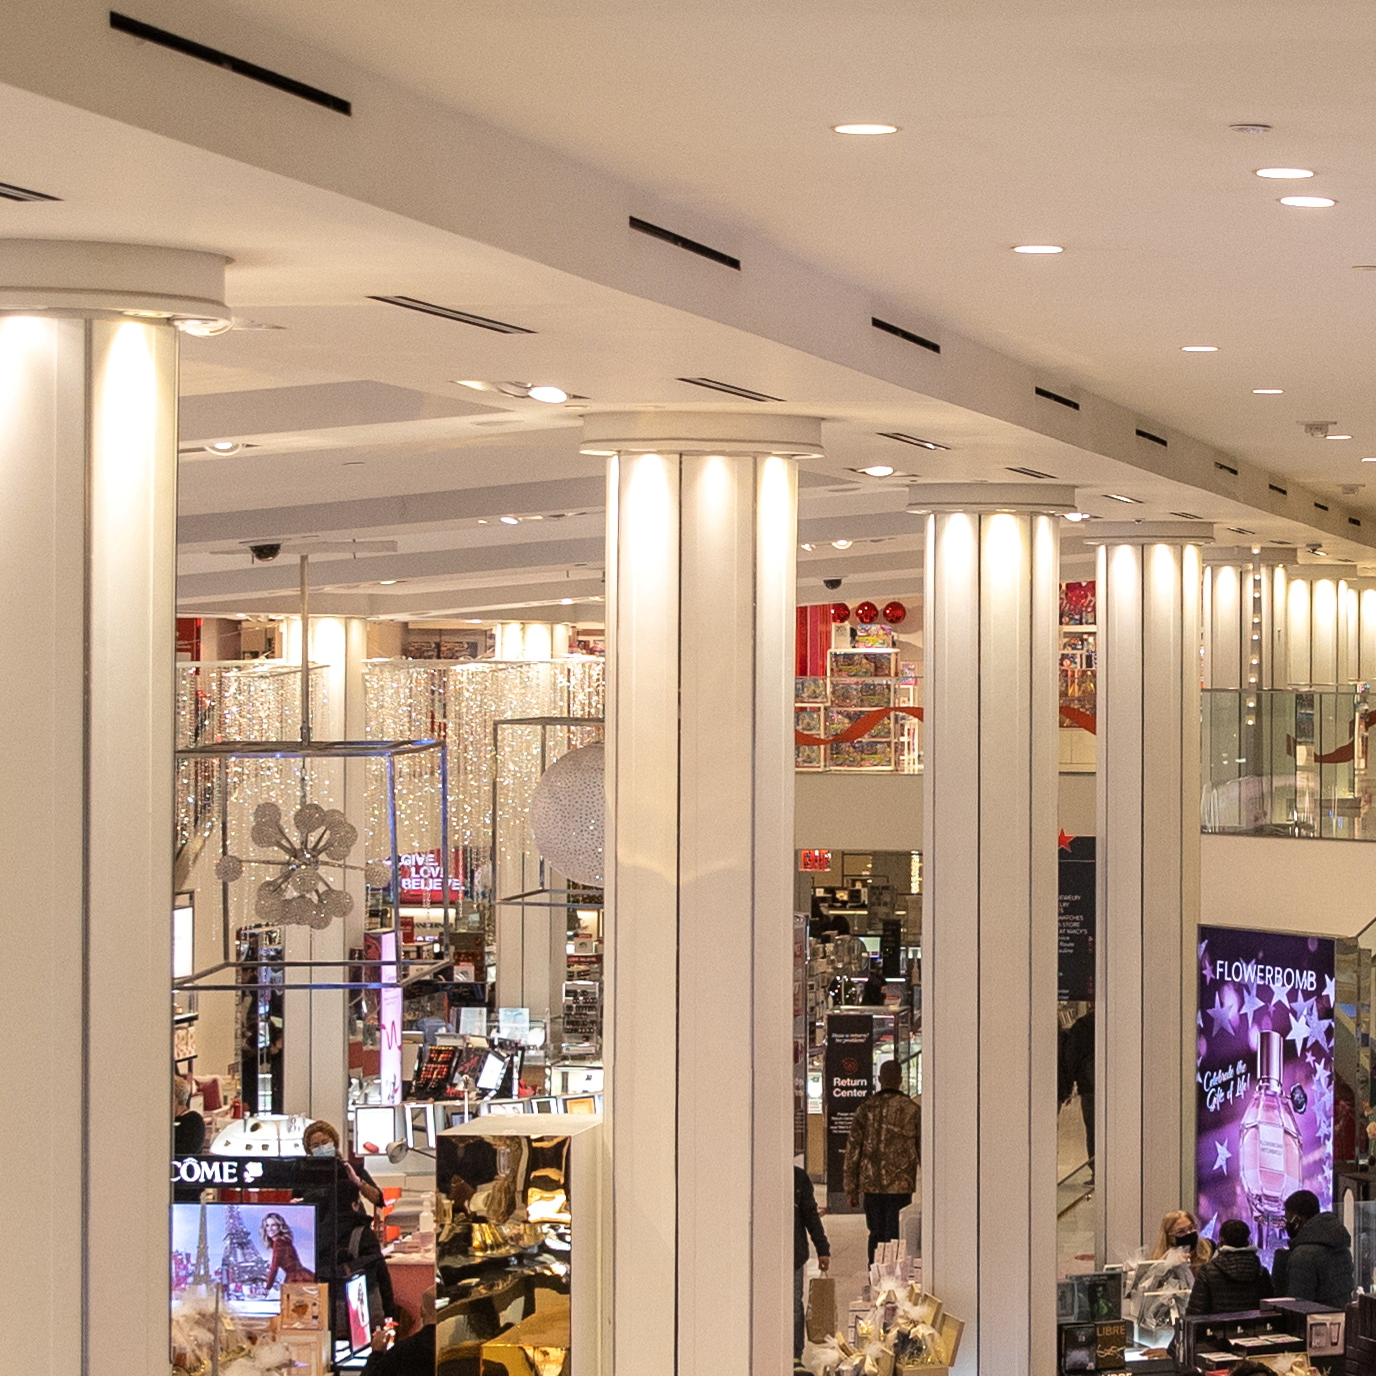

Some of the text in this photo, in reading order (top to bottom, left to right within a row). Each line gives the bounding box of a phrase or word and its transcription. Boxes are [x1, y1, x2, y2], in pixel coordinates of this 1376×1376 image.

[1216, 960, 1317, 990] FLOWERBOMB
[833, 1077, 867, 1086] Return
[1203, 1060, 1247, 1092] Celebrate the
[833, 1088, 867, 1097] Center
[1096, 1325, 1126, 1337] LIBRE
